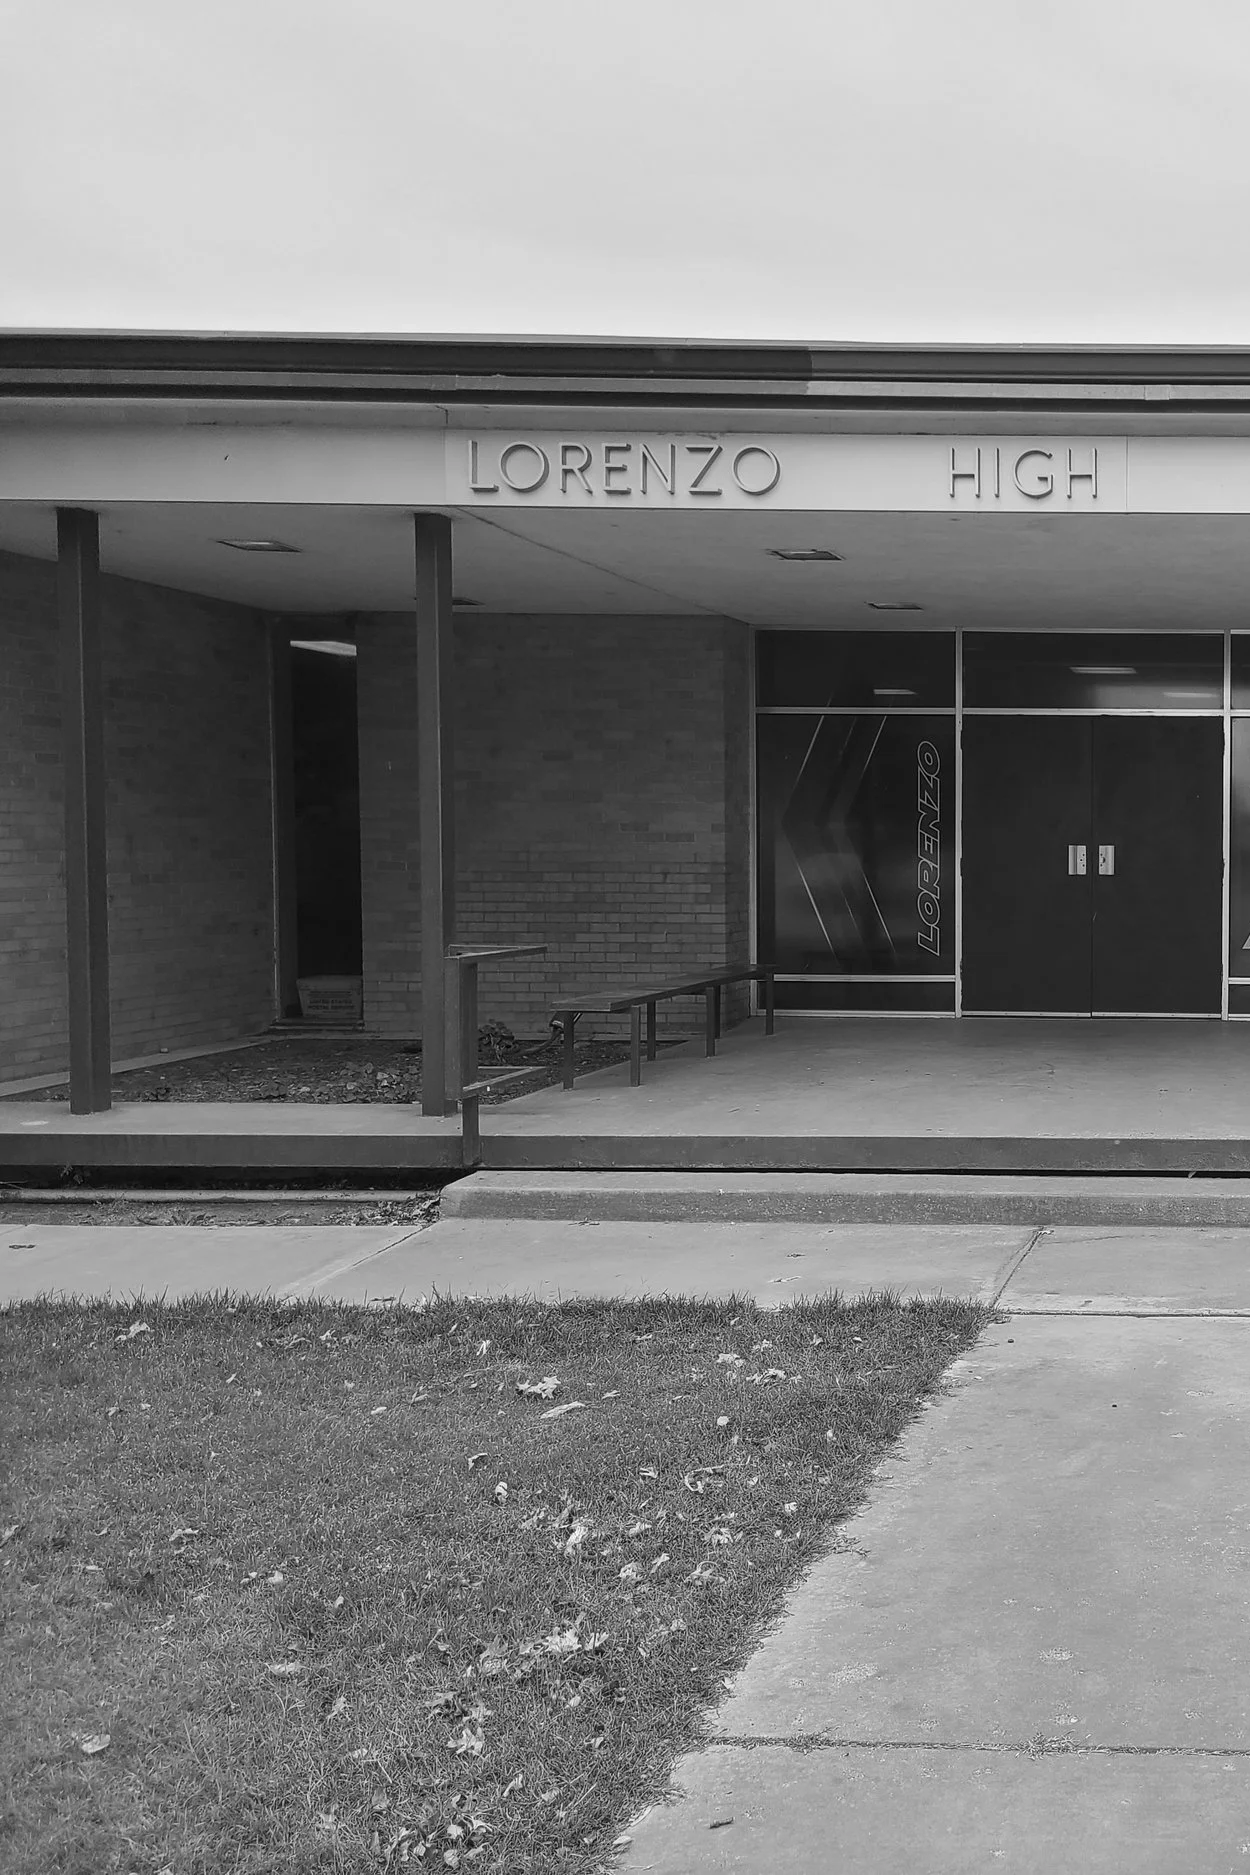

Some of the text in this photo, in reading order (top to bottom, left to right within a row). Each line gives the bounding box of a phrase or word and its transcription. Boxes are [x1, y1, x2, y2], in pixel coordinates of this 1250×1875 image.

[467, 438, 780, 496] LORENZO
[949, 446, 1096, 499] HIGH
[917, 740, 940, 956] LORENZO
